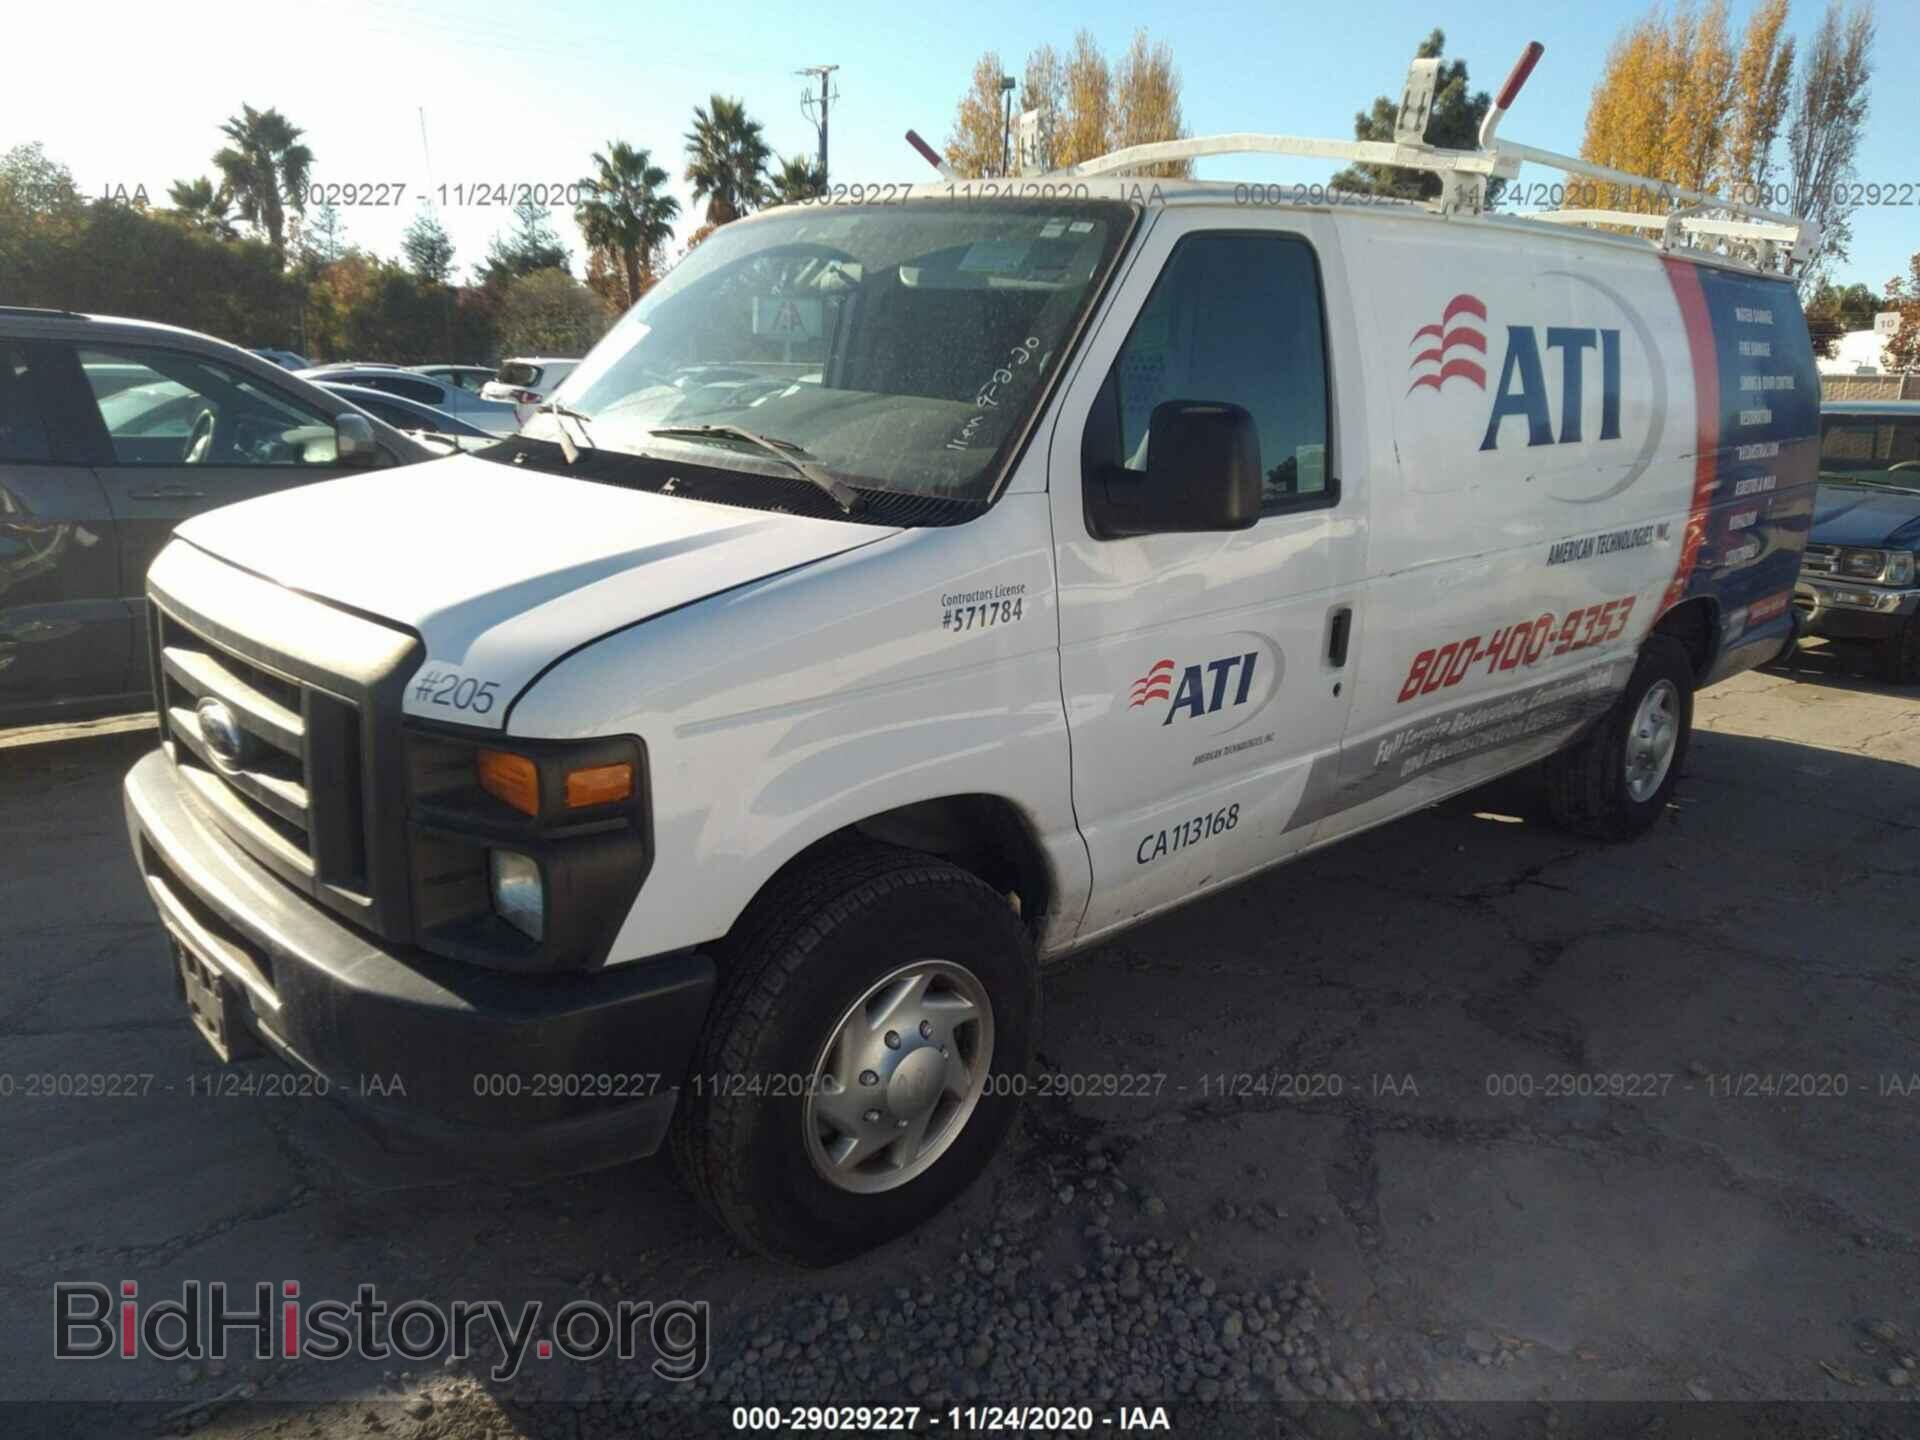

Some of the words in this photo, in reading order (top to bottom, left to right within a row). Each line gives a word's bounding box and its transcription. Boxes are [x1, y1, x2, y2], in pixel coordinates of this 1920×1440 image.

[1479, 325, 1622, 451] ATI
[941, 589, 994, 607] Contractors
[995, 583, 1026, 599] License
[941, 598, 1023, 633] #571784
[1397, 595, 1637, 703] 800-400-9353
[415, 671, 501, 714] #205
[1161, 651, 1259, 727] ATI
[1373, 731, 1406, 767] Full
